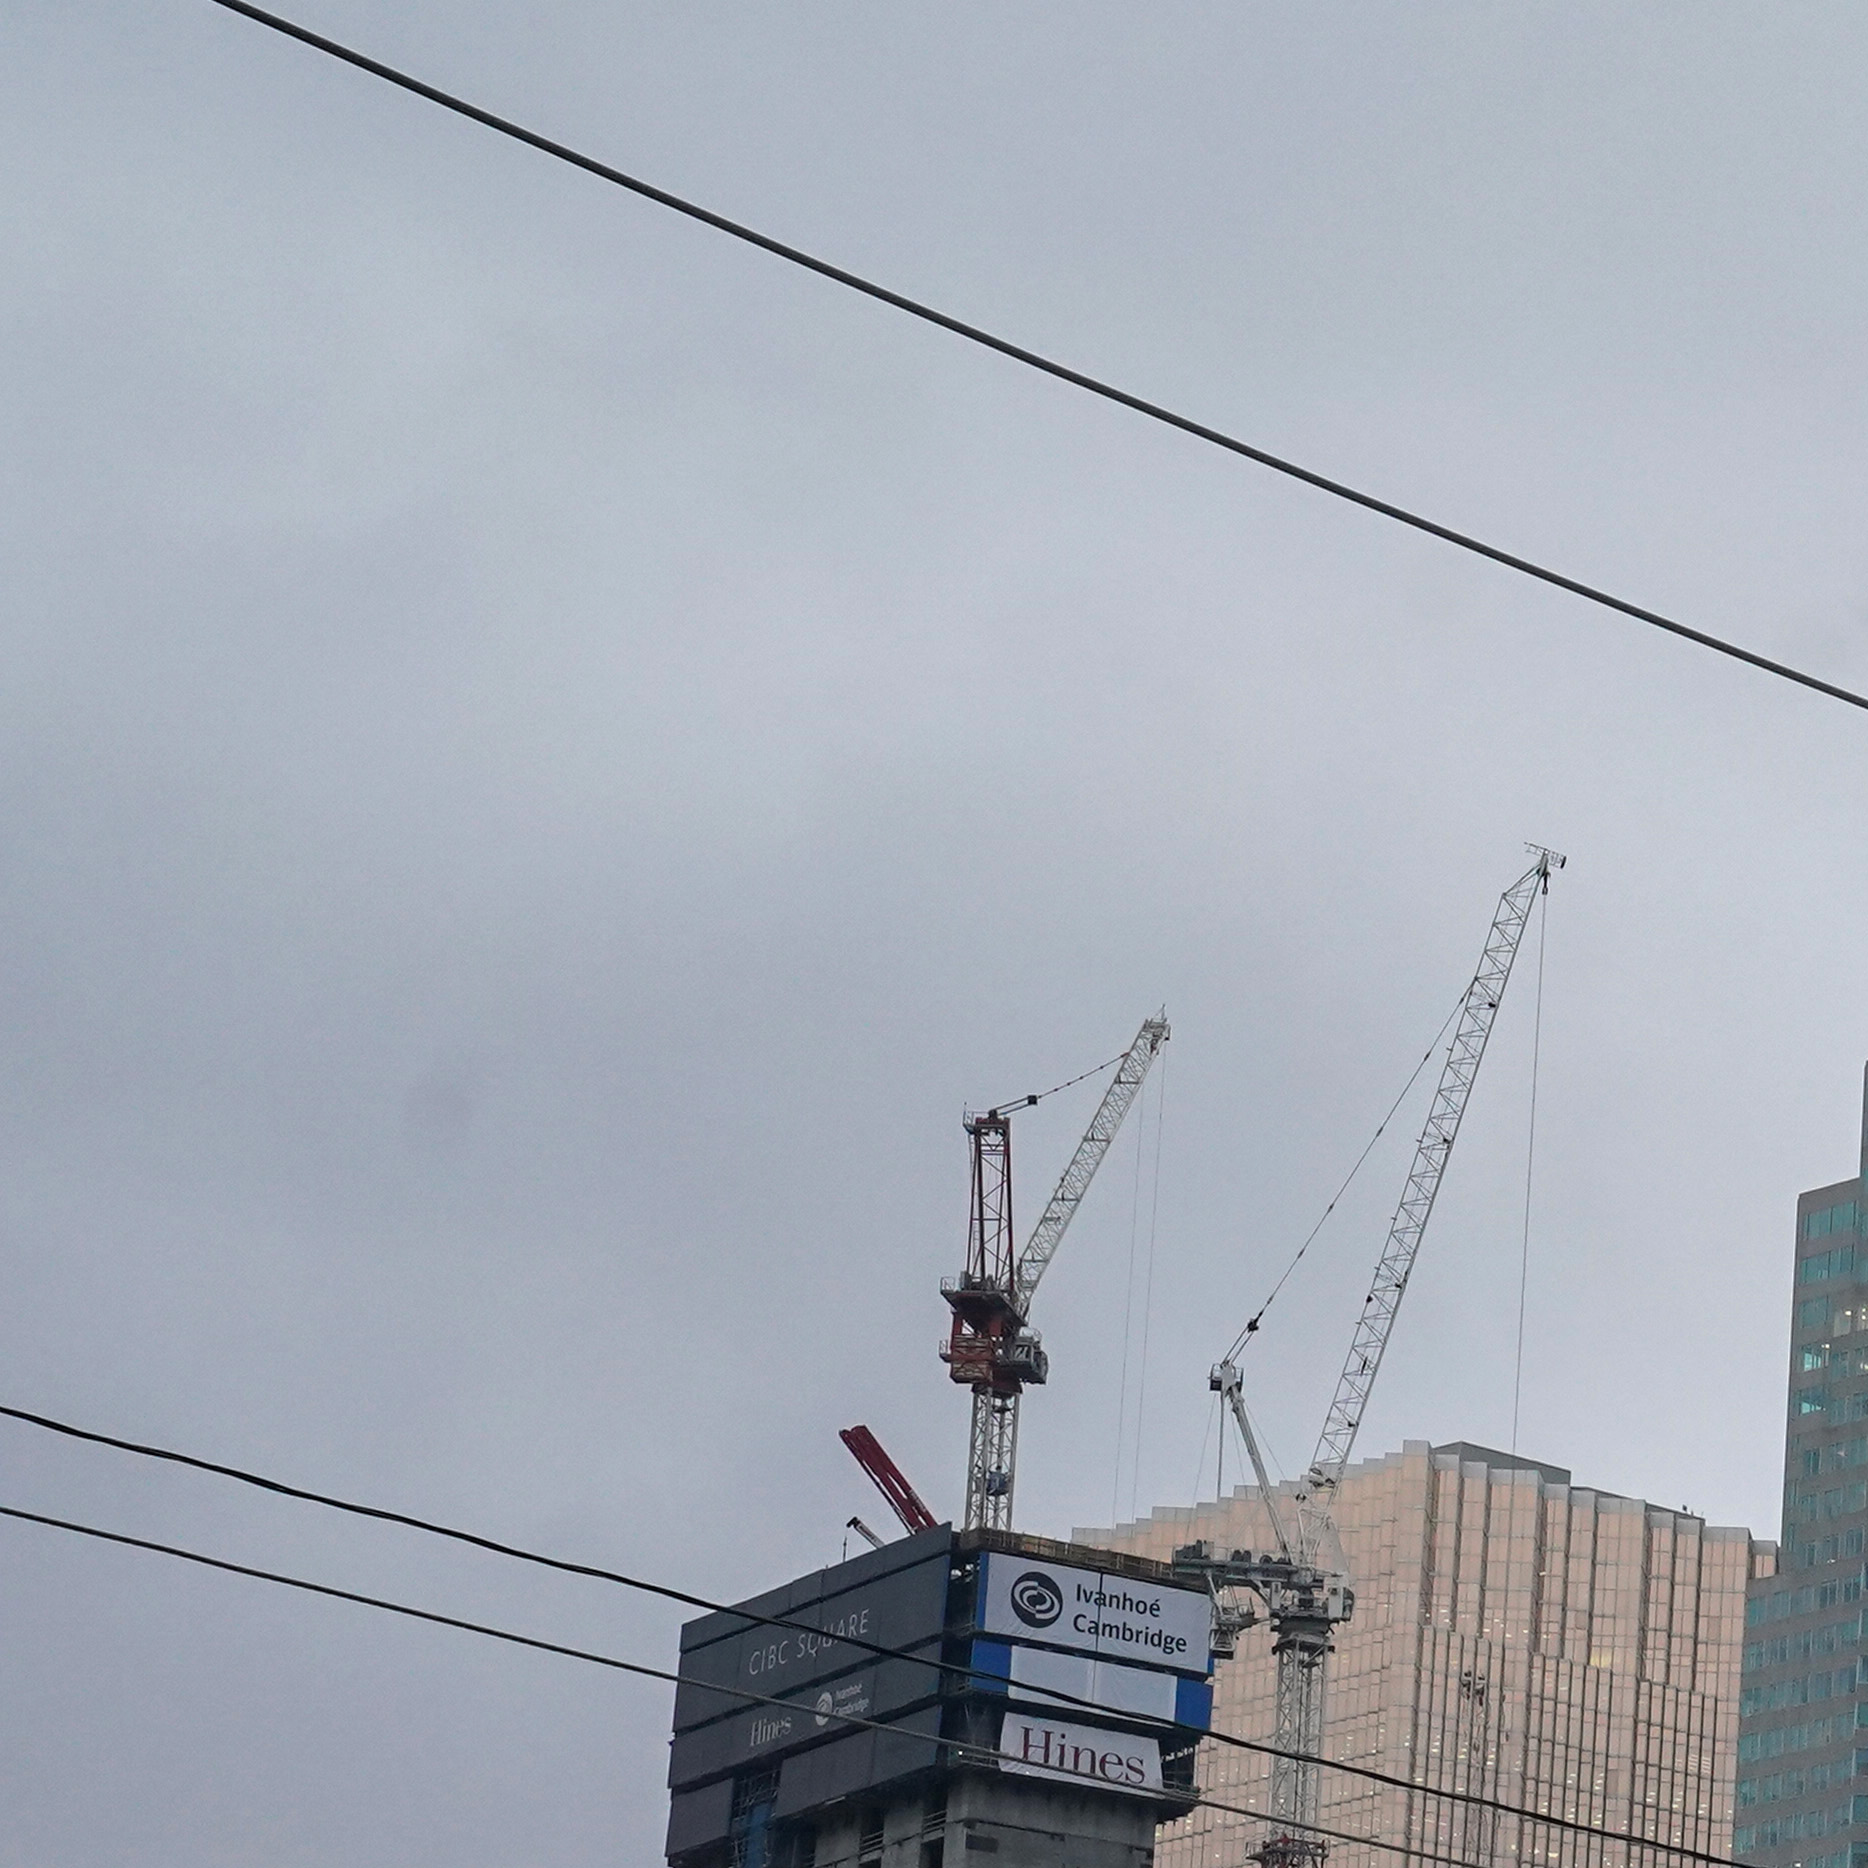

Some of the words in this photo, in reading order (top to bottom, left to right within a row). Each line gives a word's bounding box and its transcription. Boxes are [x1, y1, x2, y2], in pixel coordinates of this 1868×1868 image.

[1076, 1583, 1161, 1618] Ivanhoé
[749, 1641, 789, 1675] CIBC
[797, 1609, 869, 1657] SQUARE
[1073, 1614, 1187, 1654] Cambridge
[750, 1717, 792, 1746] Hines
[1020, 1725, 1146, 1784] Hines
